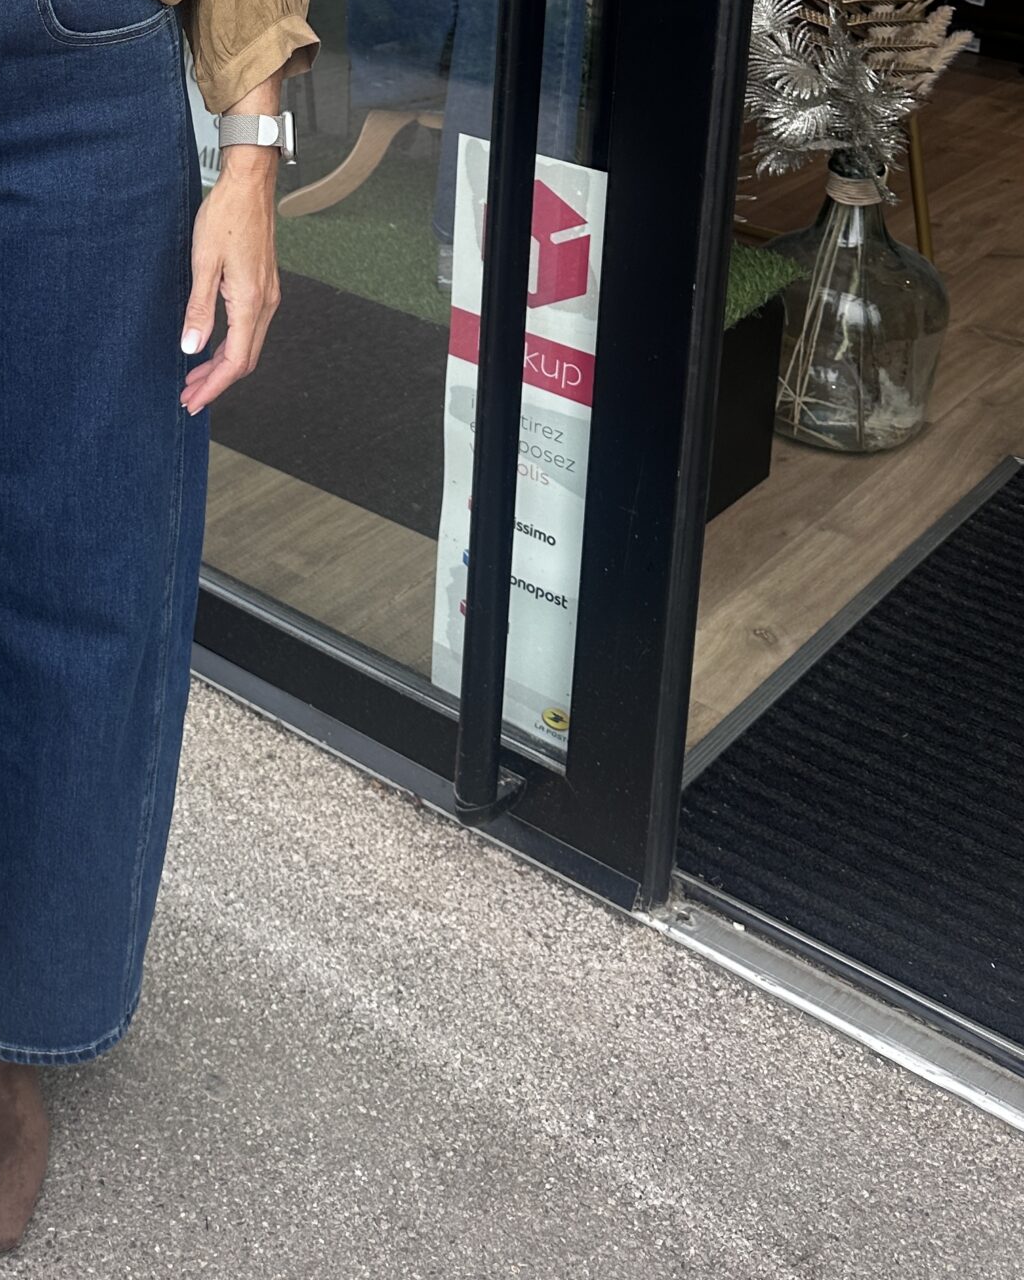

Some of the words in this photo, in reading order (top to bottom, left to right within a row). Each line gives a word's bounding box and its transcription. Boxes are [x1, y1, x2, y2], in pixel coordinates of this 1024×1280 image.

[523, 341, 582, 389] kup
[520, 414, 564, 444] tirez
[518, 439, 576, 472] posez
[517, 462, 550, 486] olis
[513, 516, 556, 546] issimo
[510, 574, 568, 610] onopost
[546, 728, 567, 743] POST
